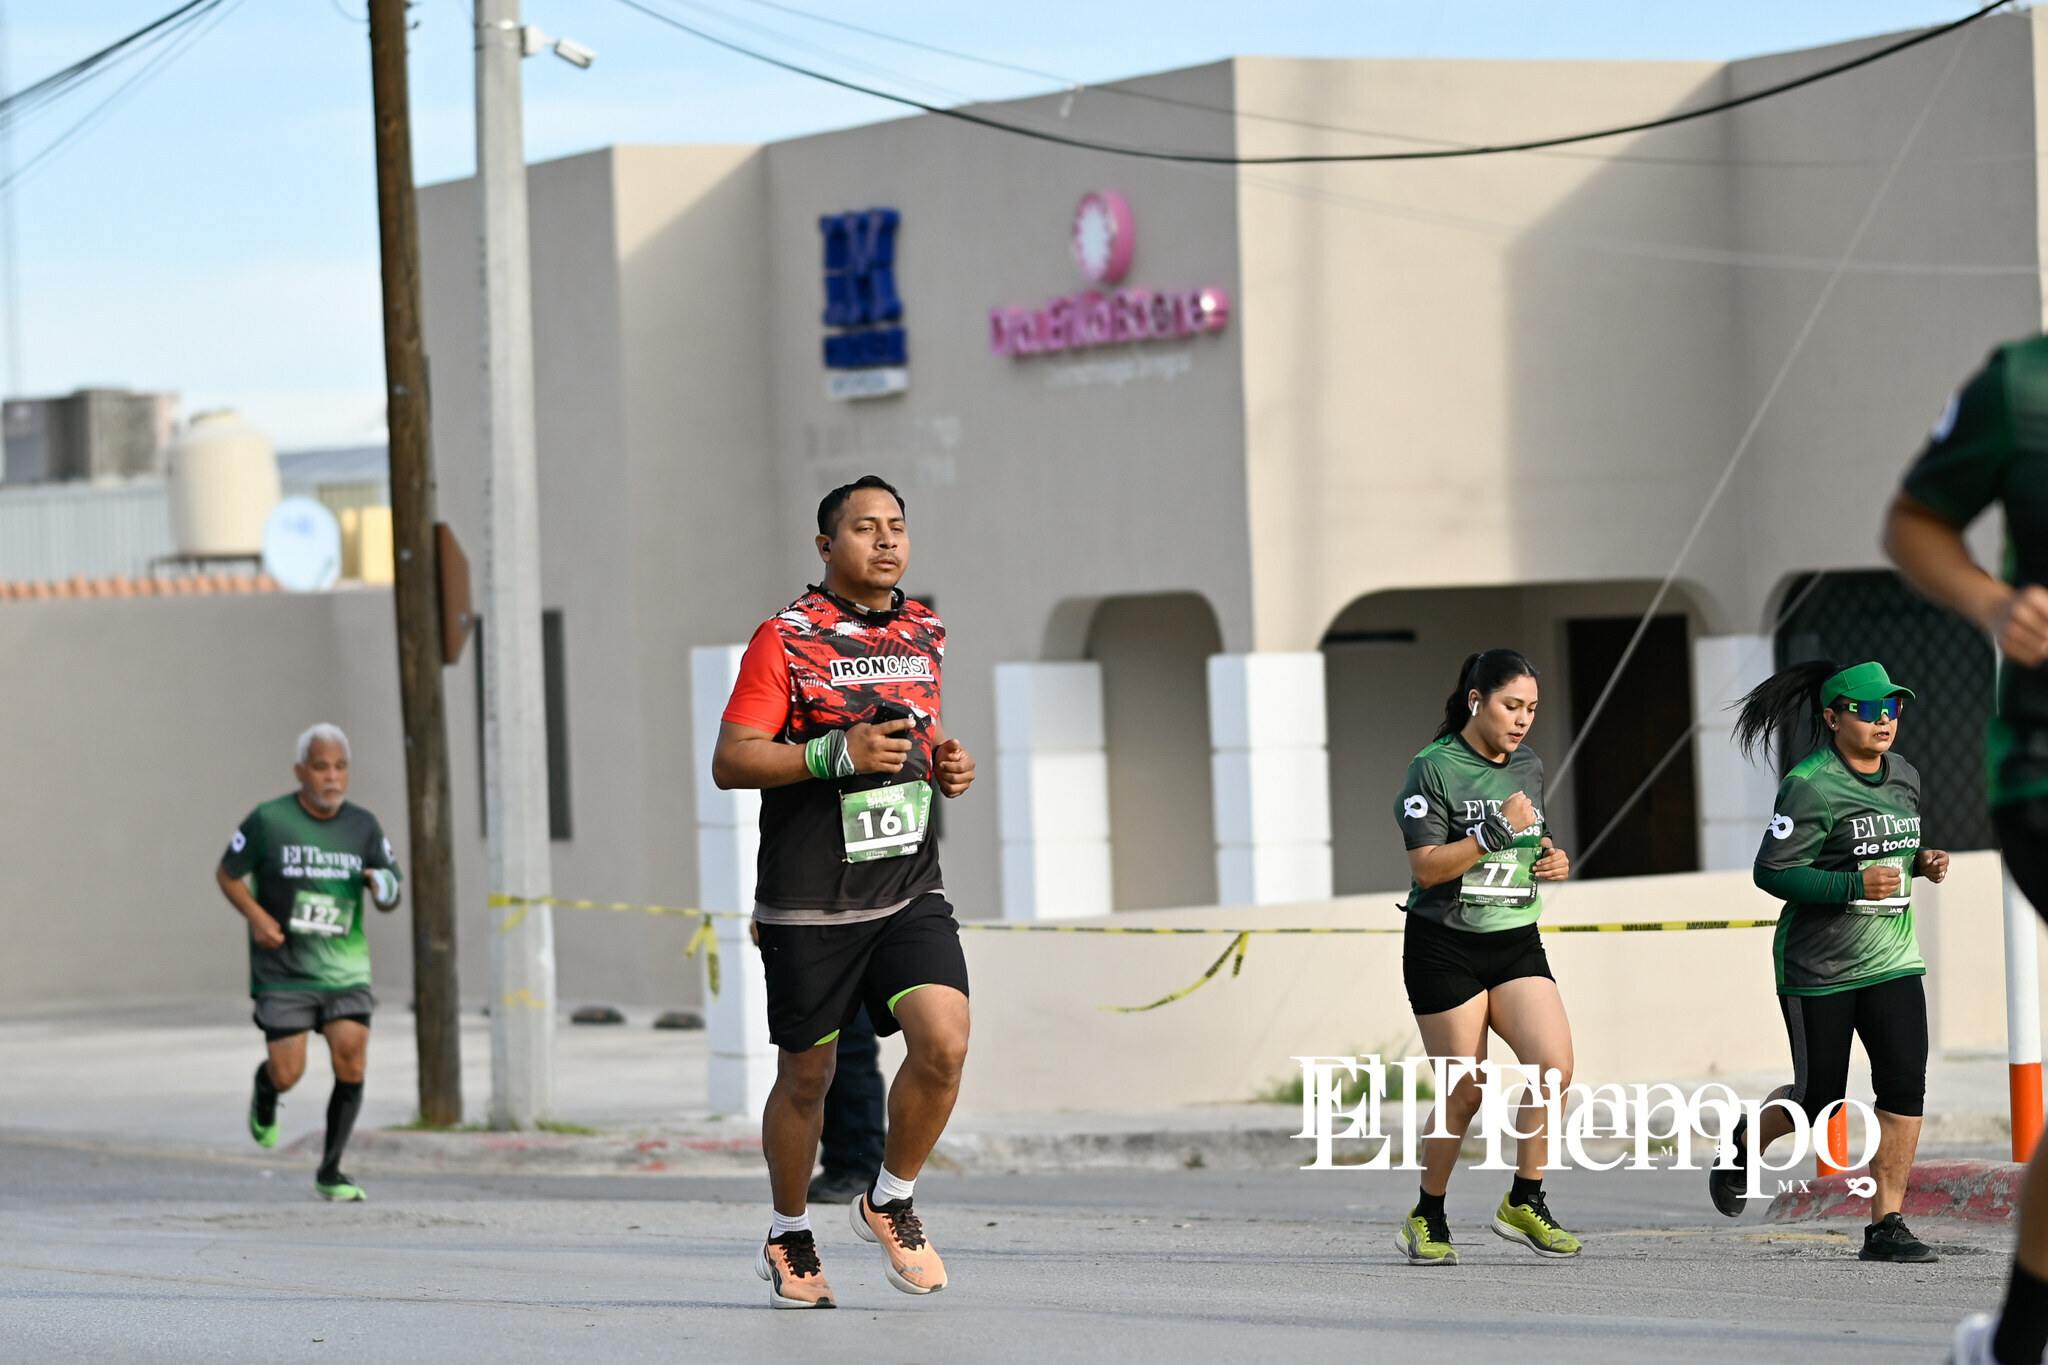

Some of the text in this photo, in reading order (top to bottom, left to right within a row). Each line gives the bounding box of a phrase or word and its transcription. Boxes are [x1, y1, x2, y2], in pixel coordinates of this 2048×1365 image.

[831, 656, 930, 677] IRONCAST
[1463, 800, 1486, 820] El
[858, 803, 916, 839] 161
[1850, 816, 1877, 840] El
[1853, 836, 1920, 856] de todos
[282, 846, 362, 871] El Tiempo
[282, 865, 350, 880] de todos
[1483, 863, 1518, 887] 77
[303, 904, 340, 925] 127
